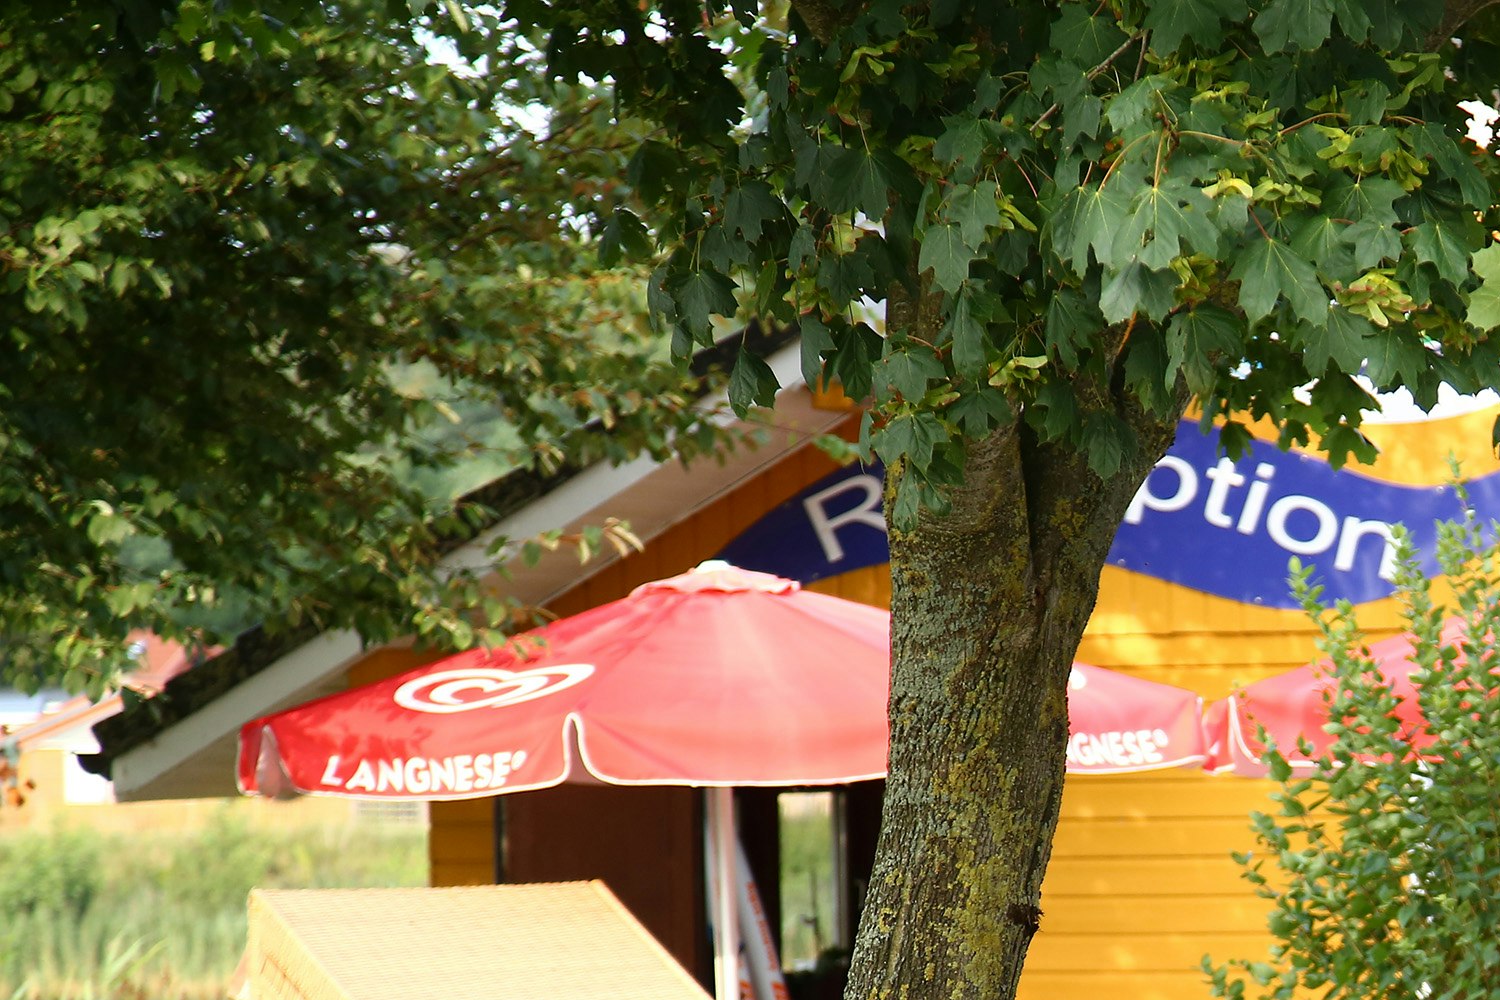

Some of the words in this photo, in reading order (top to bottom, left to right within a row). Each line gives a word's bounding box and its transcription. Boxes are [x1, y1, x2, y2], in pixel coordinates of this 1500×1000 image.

[803, 454, 1402, 582] Rption
[1066, 729, 1164, 766] GNESE
[320, 751, 512, 793] LANGNESE
